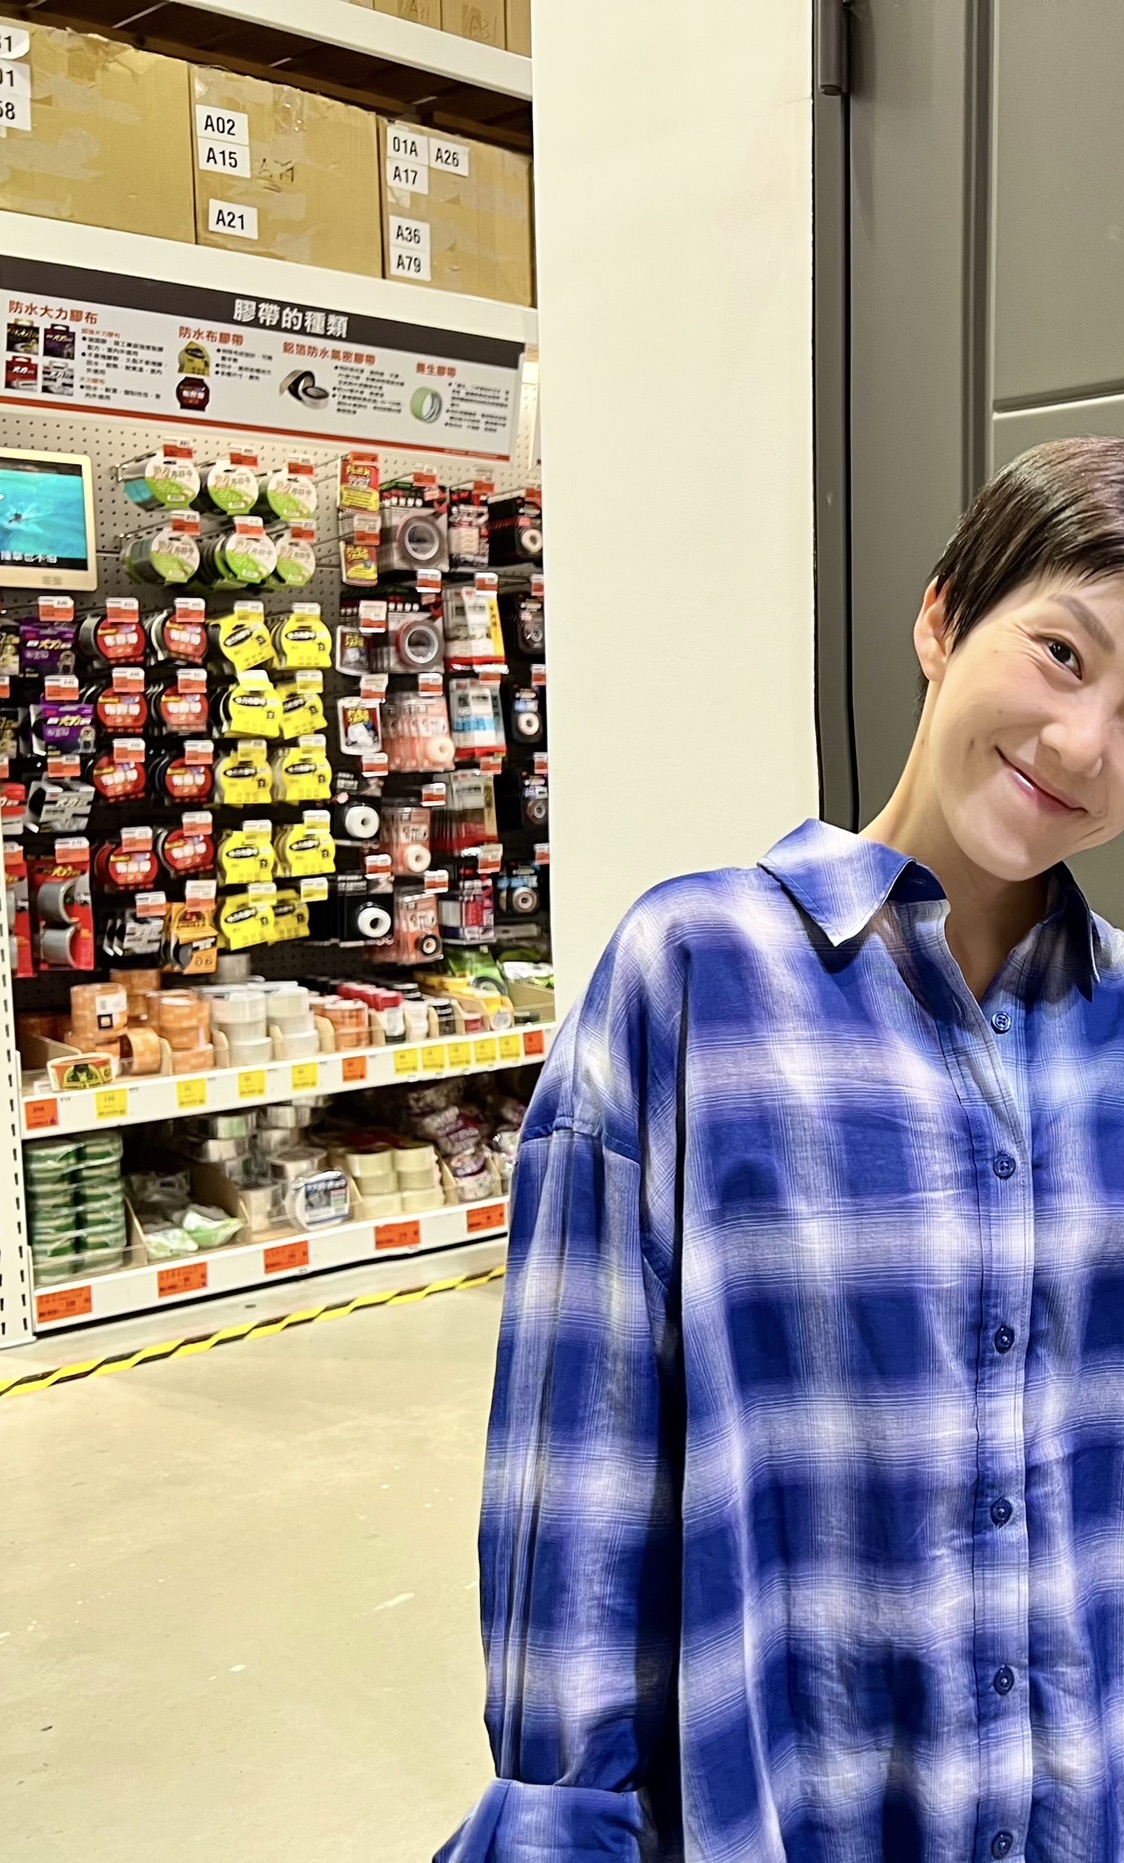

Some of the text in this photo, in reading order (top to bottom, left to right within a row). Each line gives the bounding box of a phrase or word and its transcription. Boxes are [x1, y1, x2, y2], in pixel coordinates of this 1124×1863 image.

[0, 35, 12, 52] 1
[204, 114, 236, 136] A02
[393, 136, 418, 157] 01A
[206, 147, 238, 168] A15
[435, 148, 459, 167] A26
[393, 166, 418, 185] A17
[216, 209, 245, 230] A21
[396, 225, 421, 244] A36
[396, 254, 422, 273] A79
[8, 300, 98, 325] 防水大力膠布
[233, 298, 349, 338] 膠帶的種類
[179, 326, 244, 346] 防水布膠帶
